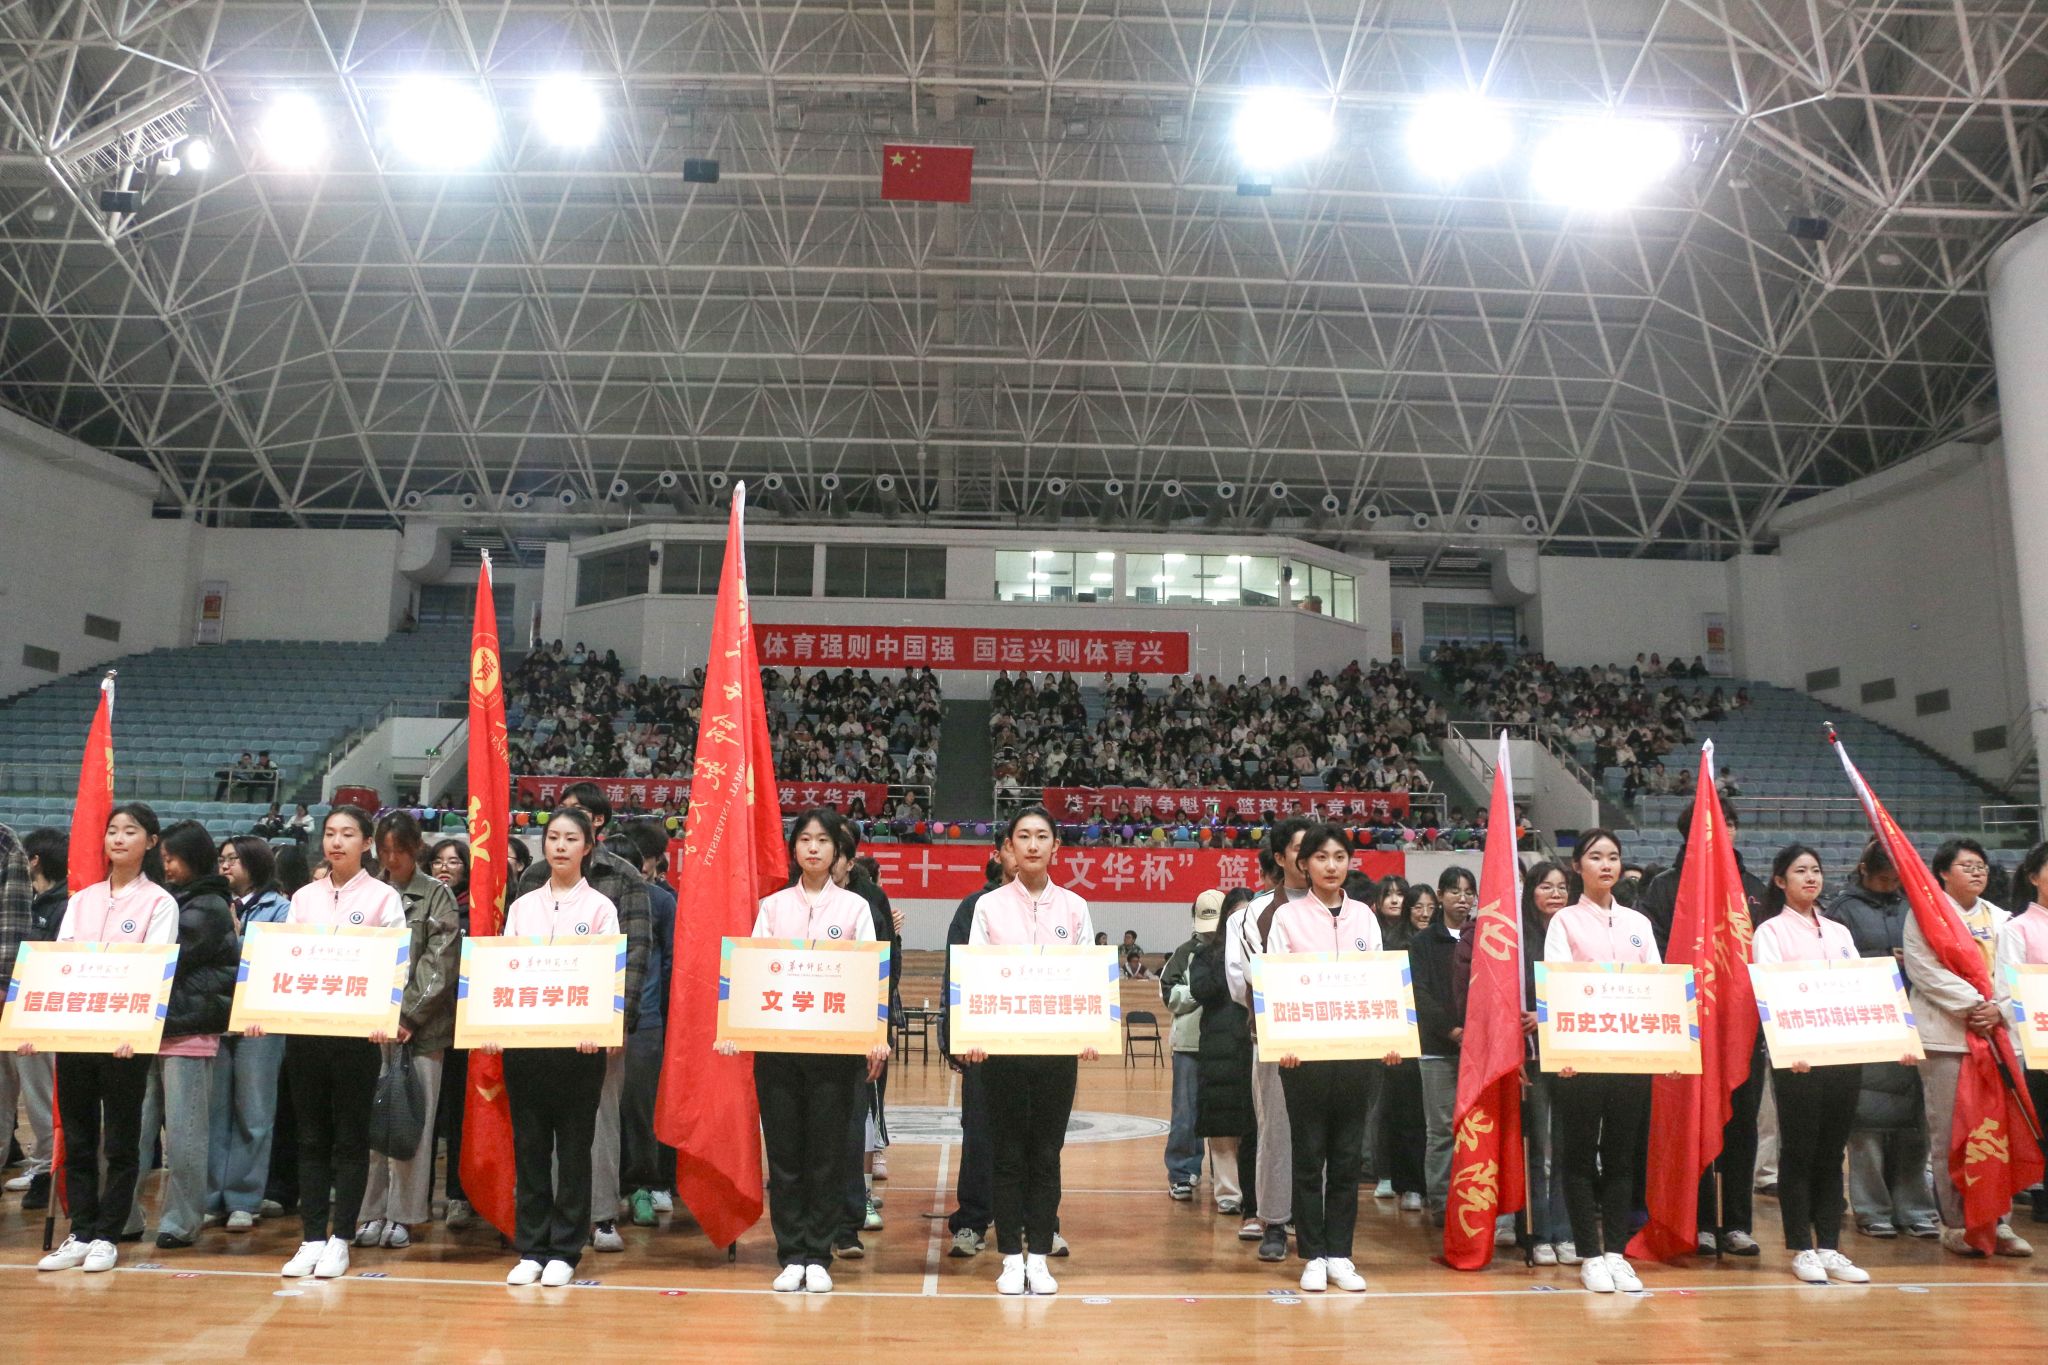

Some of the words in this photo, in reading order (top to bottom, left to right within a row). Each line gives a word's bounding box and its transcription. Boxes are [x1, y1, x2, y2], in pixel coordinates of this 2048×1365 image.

[763, 632, 955, 662] 体育强则中国强
[973, 637, 1164, 665] 国运兴则体育兴
[272, 972, 368, 997] 化学学院
[24, 991, 152, 1014] 信息管理学院
[493, 985, 589, 1008] 教育学院
[761, 990, 846, 1013] 文学院
[969, 994, 1102, 1015] 经济与工商管理学院
[1273, 999, 1399, 1022] 政治与国际关系学院
[1556, 1012, 1682, 1035] 历史文化学院
